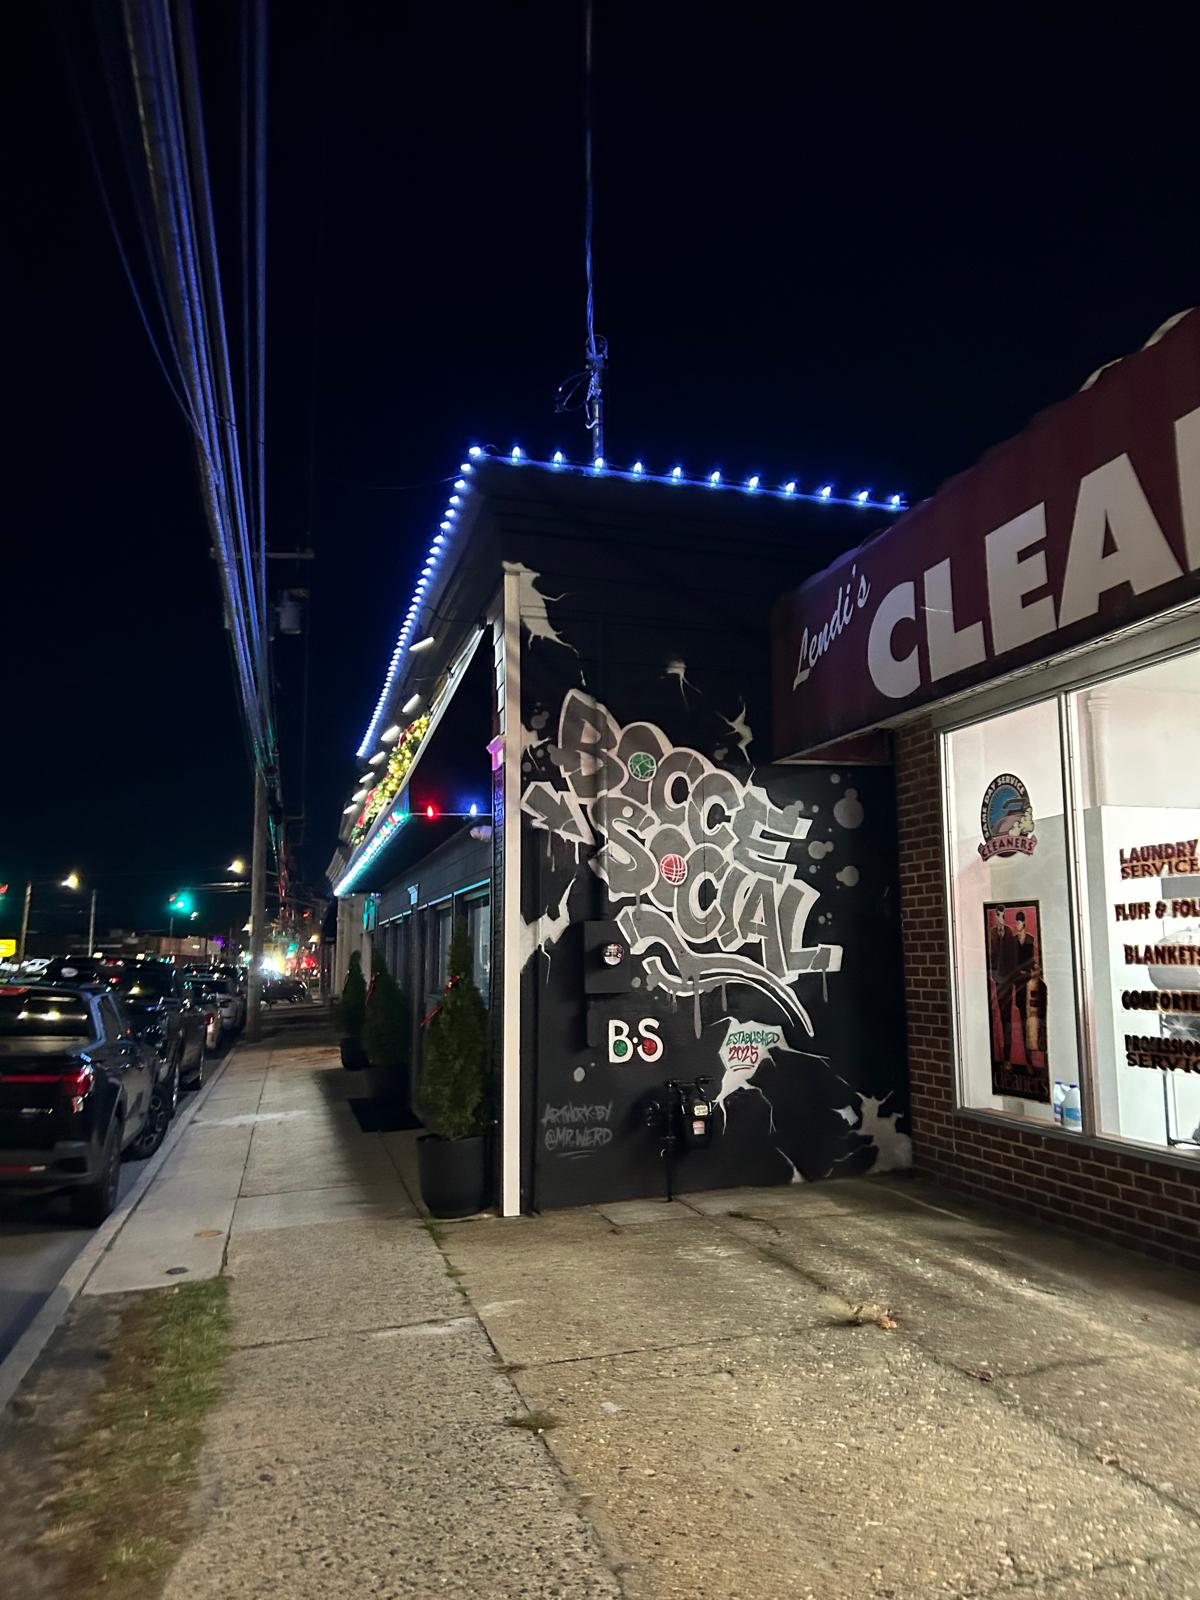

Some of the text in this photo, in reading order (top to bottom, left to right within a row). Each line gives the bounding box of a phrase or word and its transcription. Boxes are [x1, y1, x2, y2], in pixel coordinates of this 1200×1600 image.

[793, 564, 871, 691] Lendi's
[985, 784, 997, 804] DAY
[997, 775, 1026, 795] SERVICE
[982, 837, 1034, 858] CLEANERS
[1119, 839, 1199, 865] LAUNDRY
[587, 794, 843, 985] SOCIAL
[1114, 897, 1200, 922] FLUFF & FOL
[726, 1029, 780, 1047] ESTABLISHED
[728, 1044, 759, 1064] 2025
